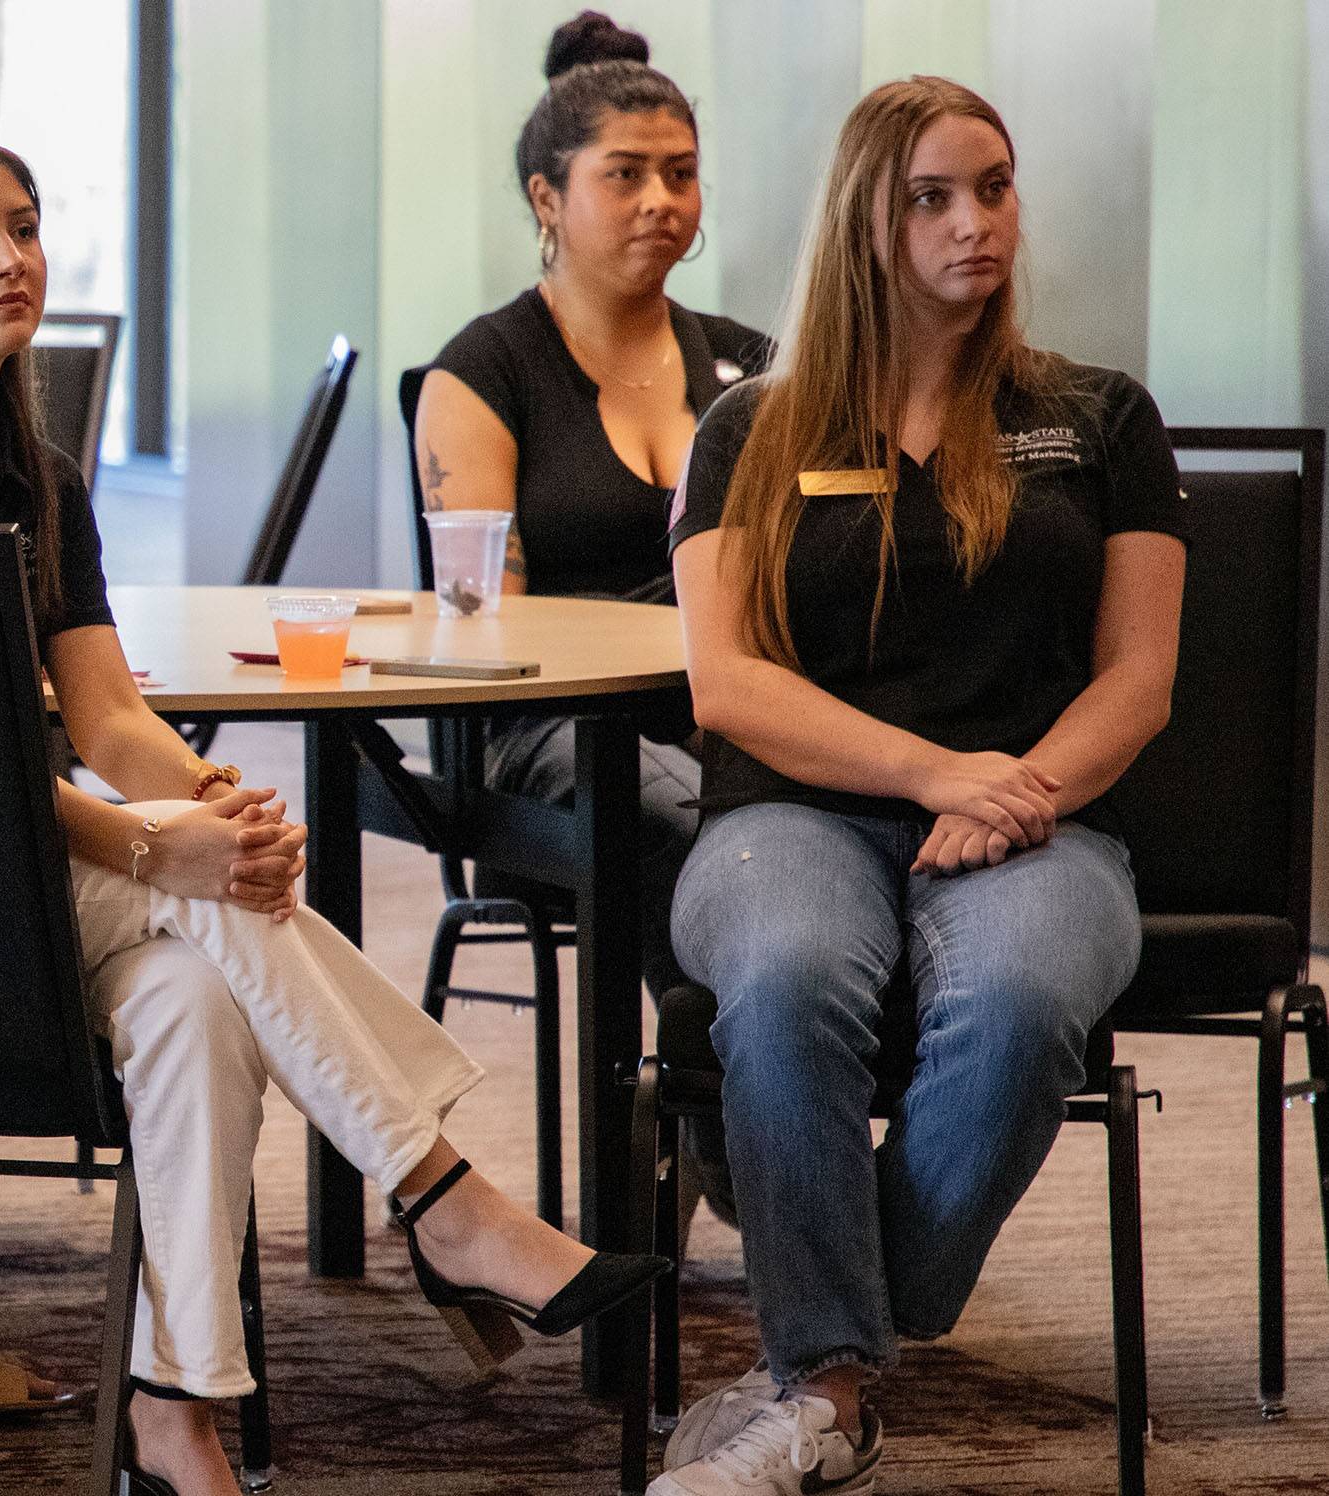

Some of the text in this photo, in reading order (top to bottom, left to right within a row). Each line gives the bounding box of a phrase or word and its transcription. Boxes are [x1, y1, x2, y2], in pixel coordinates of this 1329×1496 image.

[1031, 428, 1074, 439] STATE
[1015, 454, 1025, 462] of
[1028, 450, 1080, 463] Marketing
